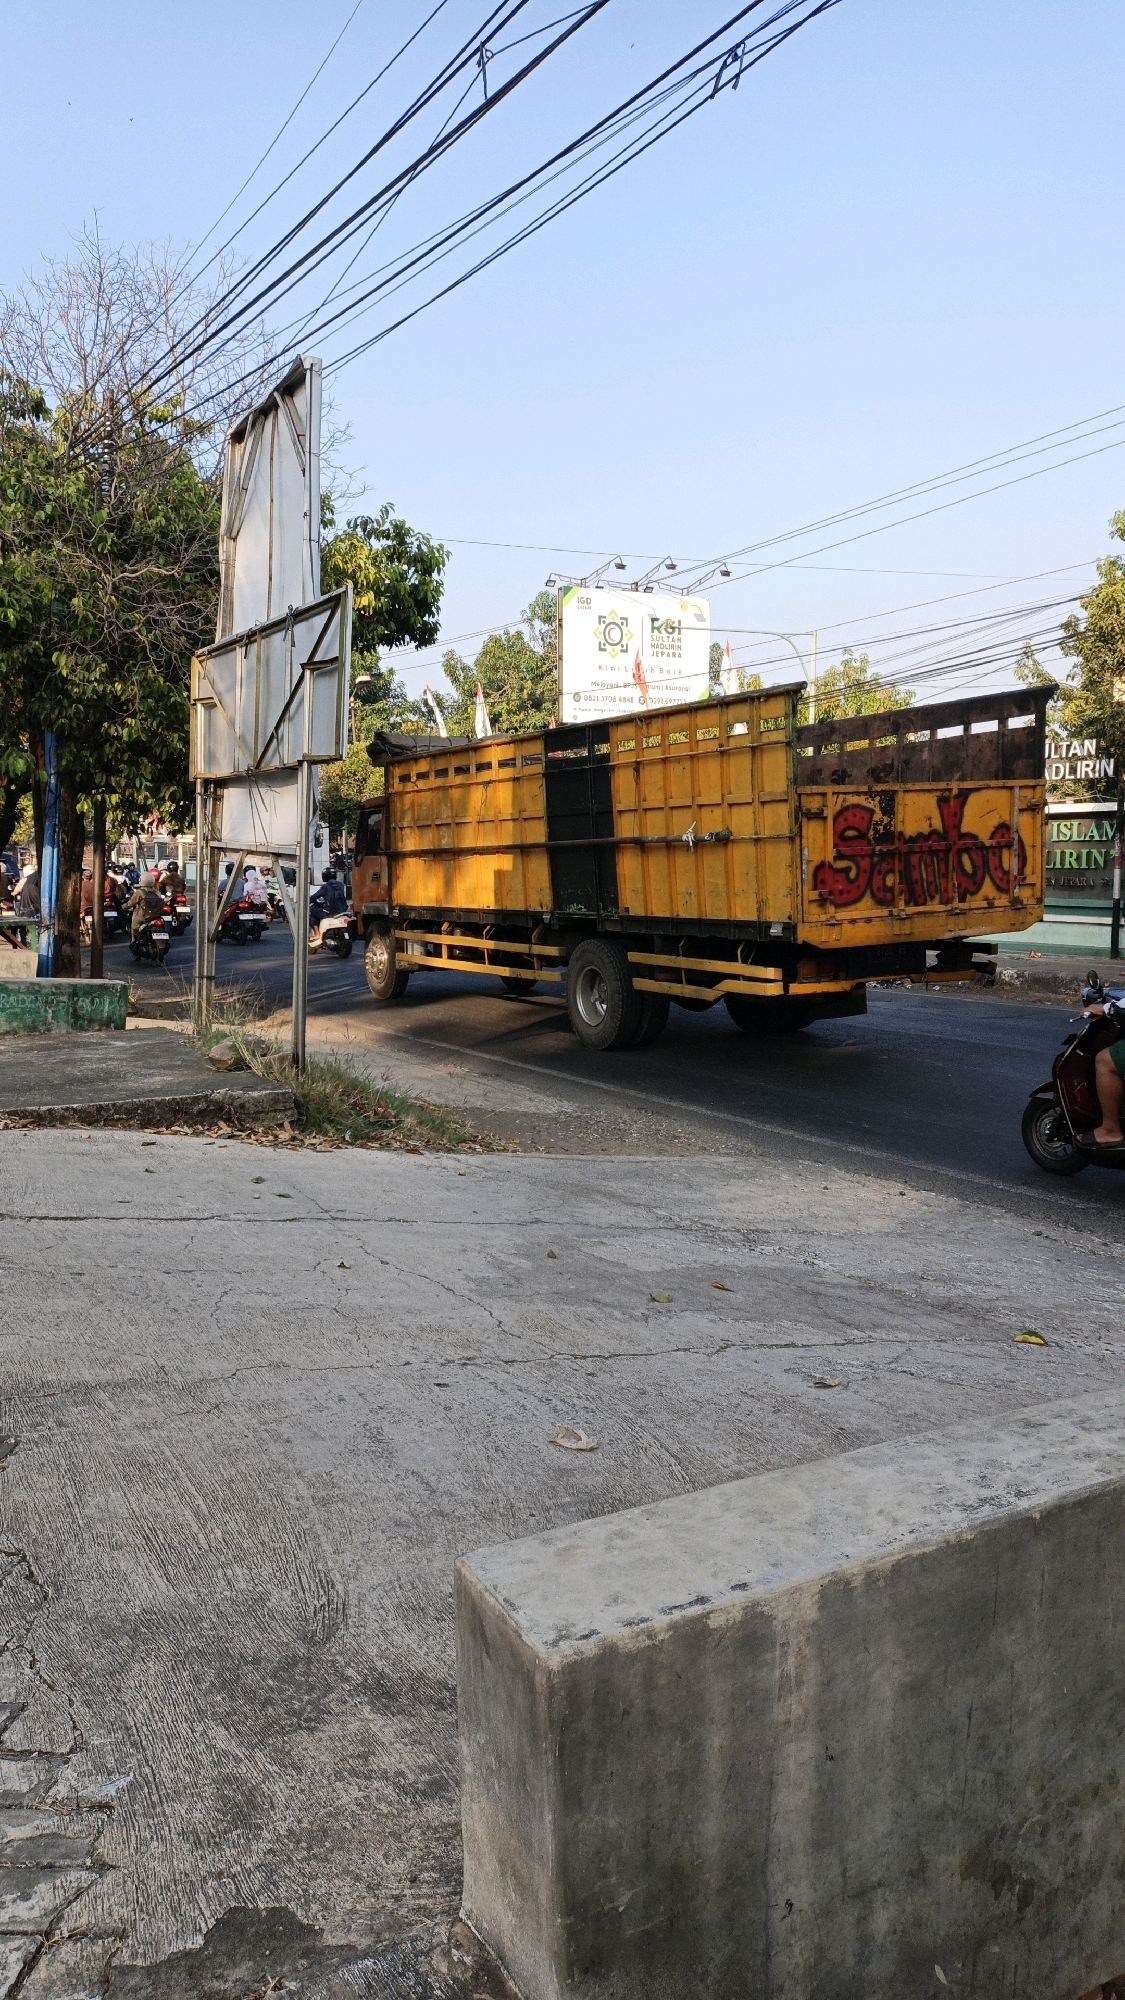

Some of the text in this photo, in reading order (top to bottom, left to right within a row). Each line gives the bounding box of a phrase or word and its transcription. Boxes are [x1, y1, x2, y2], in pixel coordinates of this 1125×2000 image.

[577, 596, 592, 605] IGD
[650, 634, 682, 643] SULTAN
[650, 642, 682, 651] HADLIRIN
[650, 650, 682, 659] JEPARA
[598, 664, 620, 672] Kini
[583, 694, 599, 702] 0821
